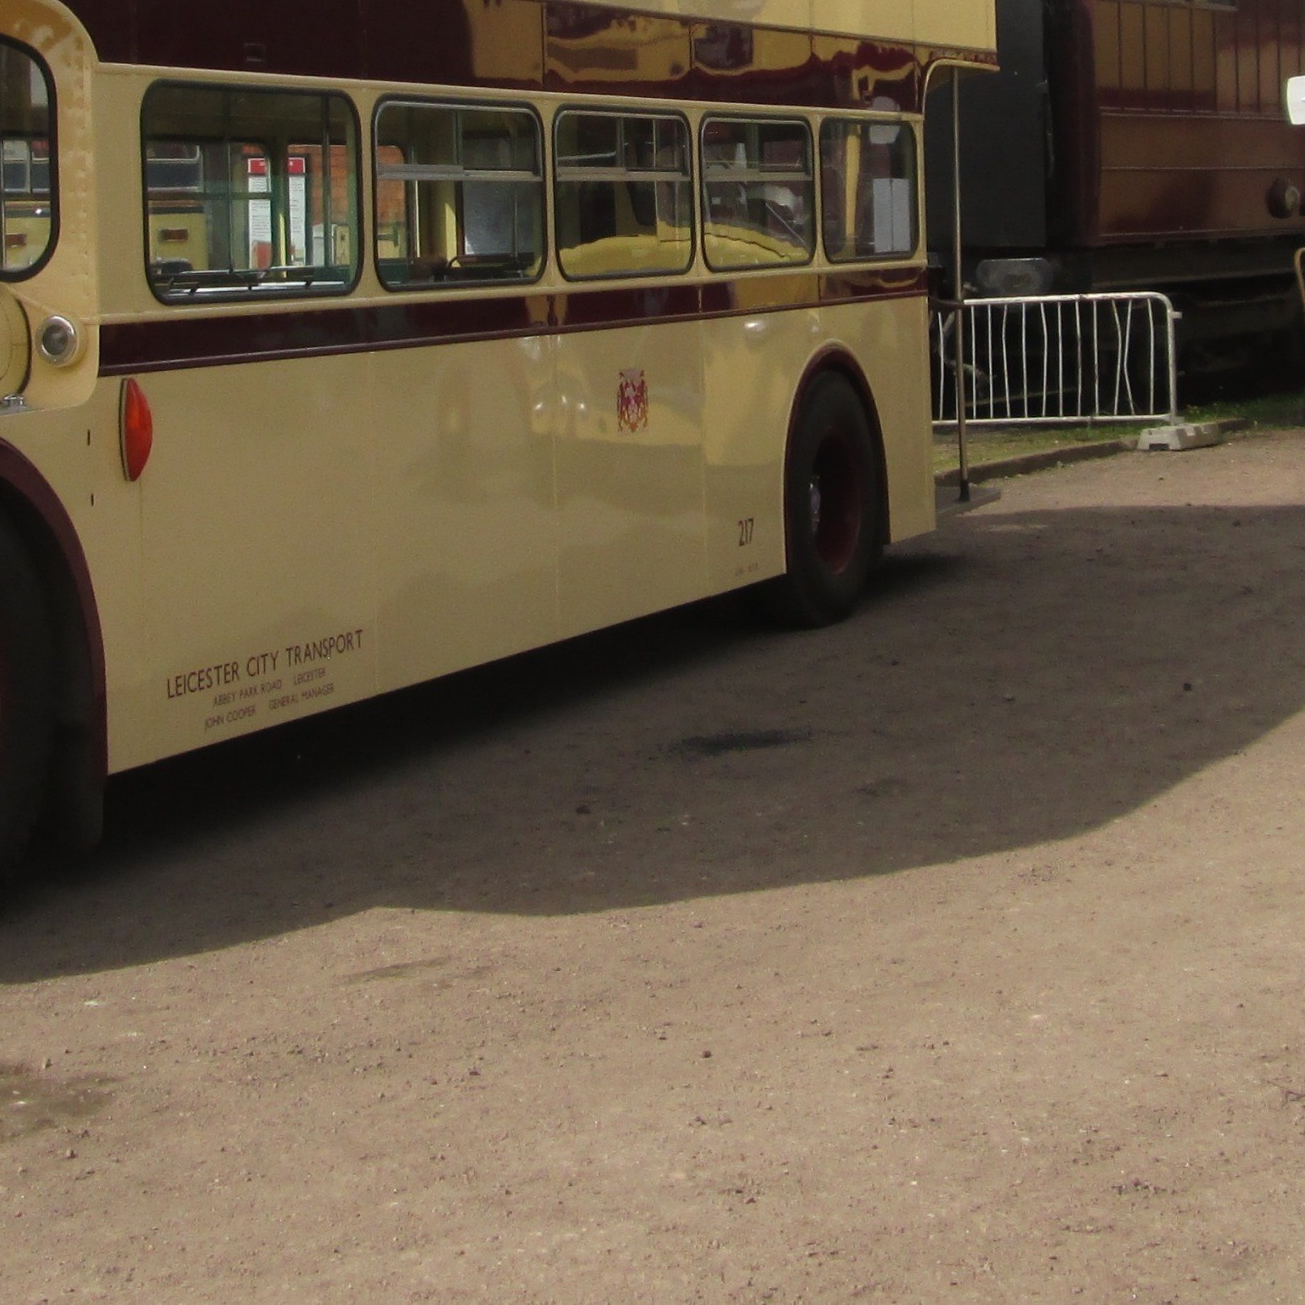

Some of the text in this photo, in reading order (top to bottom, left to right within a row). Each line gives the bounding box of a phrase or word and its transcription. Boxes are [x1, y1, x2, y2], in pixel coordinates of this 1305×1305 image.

[738, 518, 754, 547] 217
[166, 629, 364, 699] LEICESTER CITY TRANSPORT
[261, 679, 283, 694] ROAD
